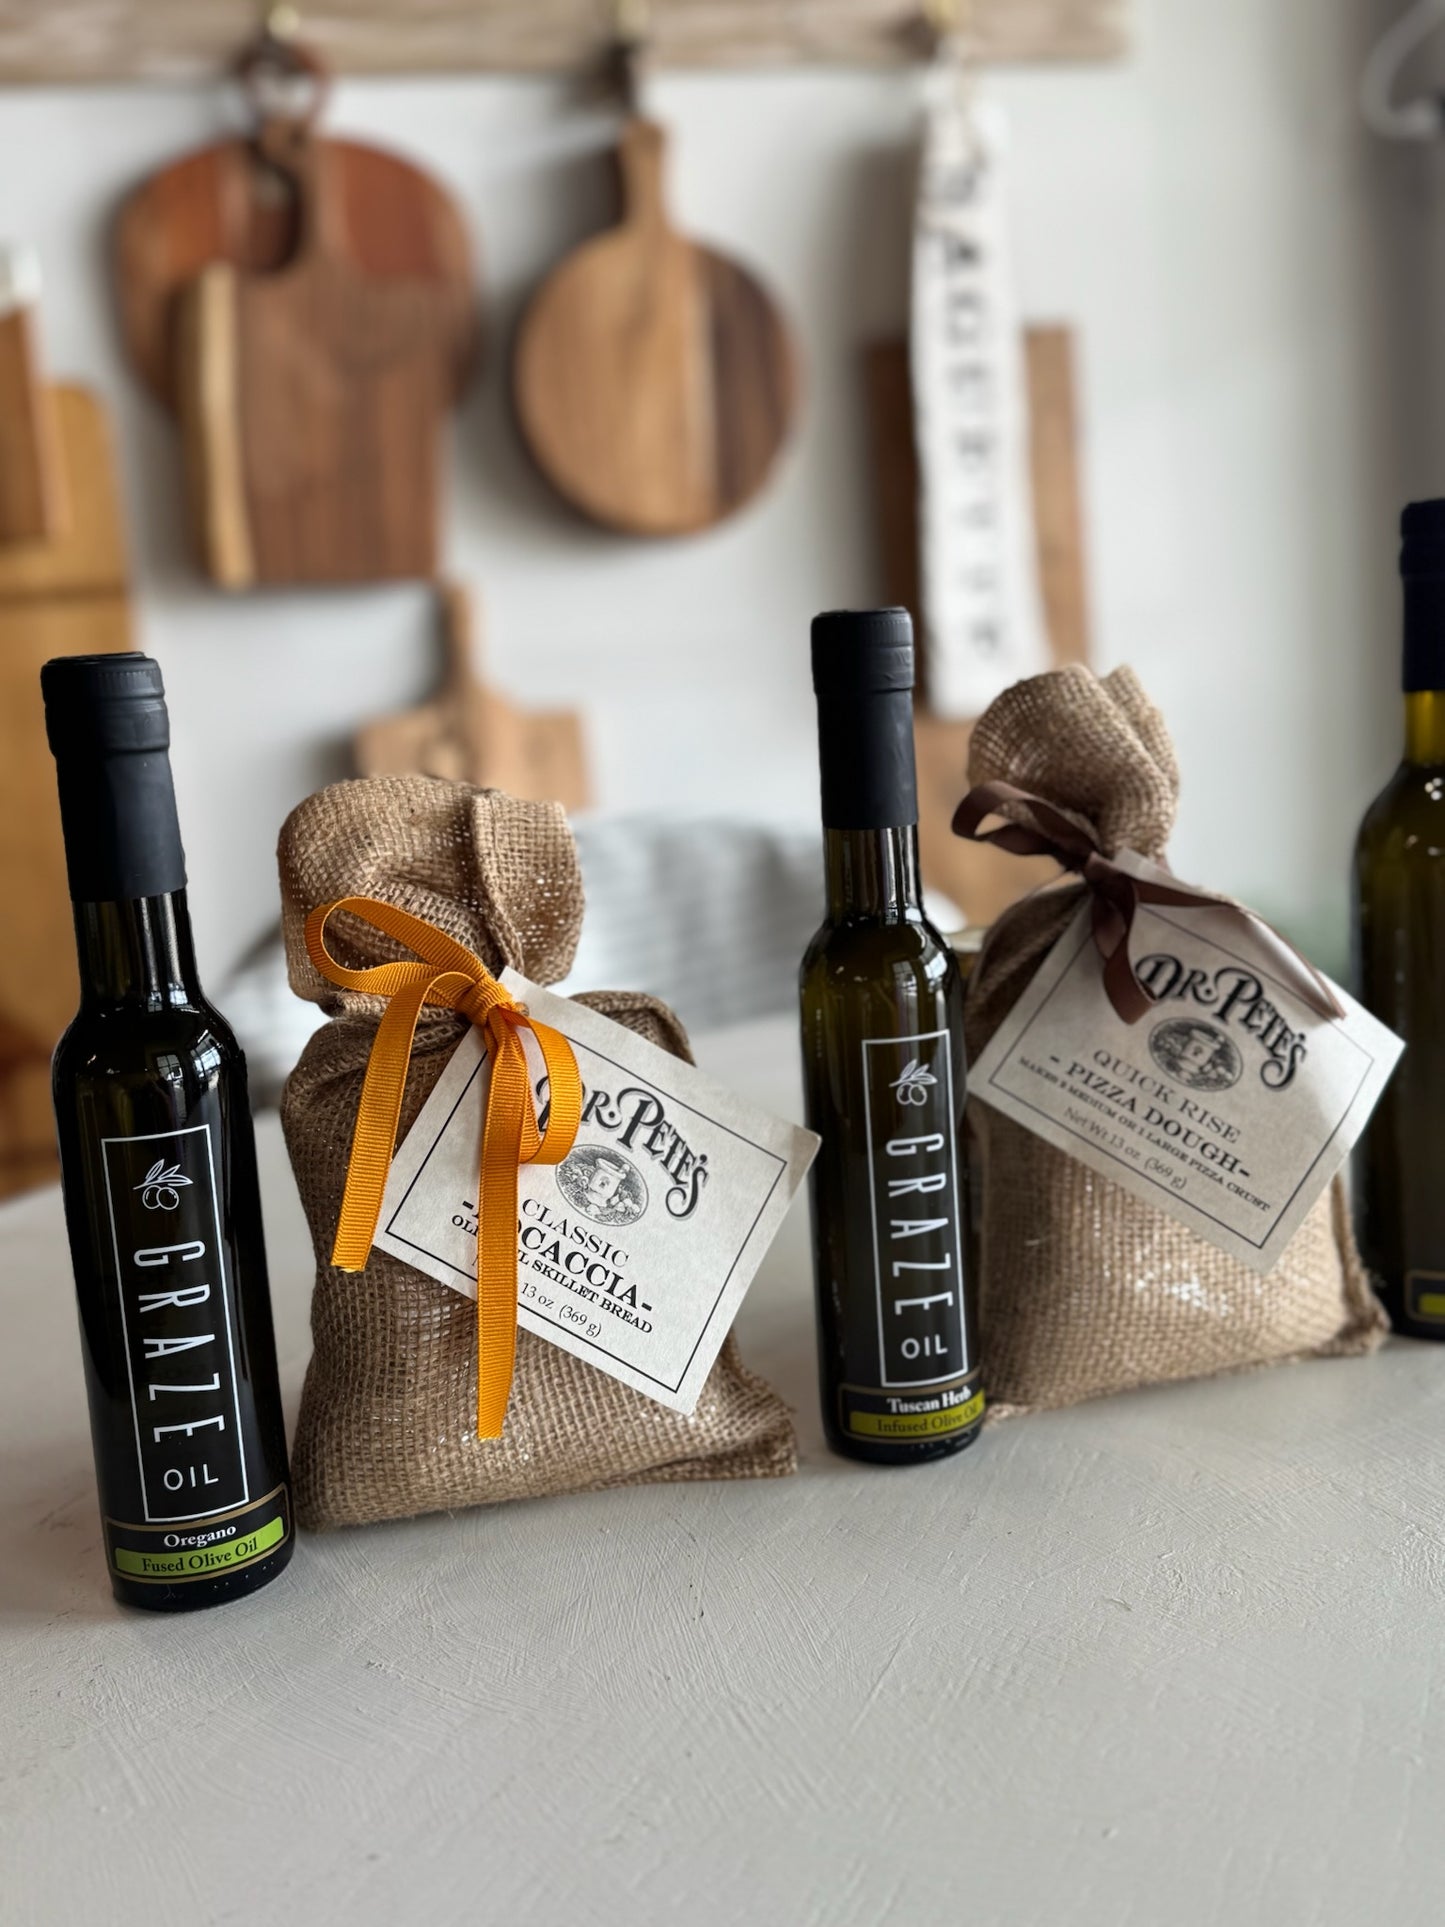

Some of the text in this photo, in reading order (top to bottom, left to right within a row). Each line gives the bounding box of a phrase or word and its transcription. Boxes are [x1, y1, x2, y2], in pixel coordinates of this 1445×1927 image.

[1212, 966, 1307, 1091] PETE'S
[1066, 1061, 1137, 1114] PIZZA
[1093, 1048, 1241, 1144] QUICK RISE
[617, 1087, 709, 1219] PETE'S
[1063, 1106, 1088, 1129] Net
[1108, 1134, 1125, 1149] 13
[1124, 1146, 1141, 1160] oz
[1068, 1085, 1117, 1118] MEDIUM
[1118, 1114, 1138, 1131] OR
[1144, 1130, 1188, 1162] LARGE
[1188, 1158, 1224, 1184] PIZZA
[1226, 1181, 1271, 1212] CRUST
[522, 1198, 629, 1268] CLASSIC
[886, 1133, 953, 1315] GRAZE
[522, 1282, 602, 1338] 13 oz (369 g)
[532, 1259, 599, 1302] SKILLET
[600, 1298, 653, 1334] BREAD
[133, 1240, 225, 1443] GRAZE
[901, 1334, 948, 1359] OIL
[877, 1418, 928, 1432] Infused
[931, 1414, 962, 1429] Olive
[886, 1385, 972, 1413] Tuscan Herb
[163, 1463, 219, 1490] OIL
[142, 1537, 258, 1573] Fused Olive Oil
[163, 1526, 237, 1548] Oregano
